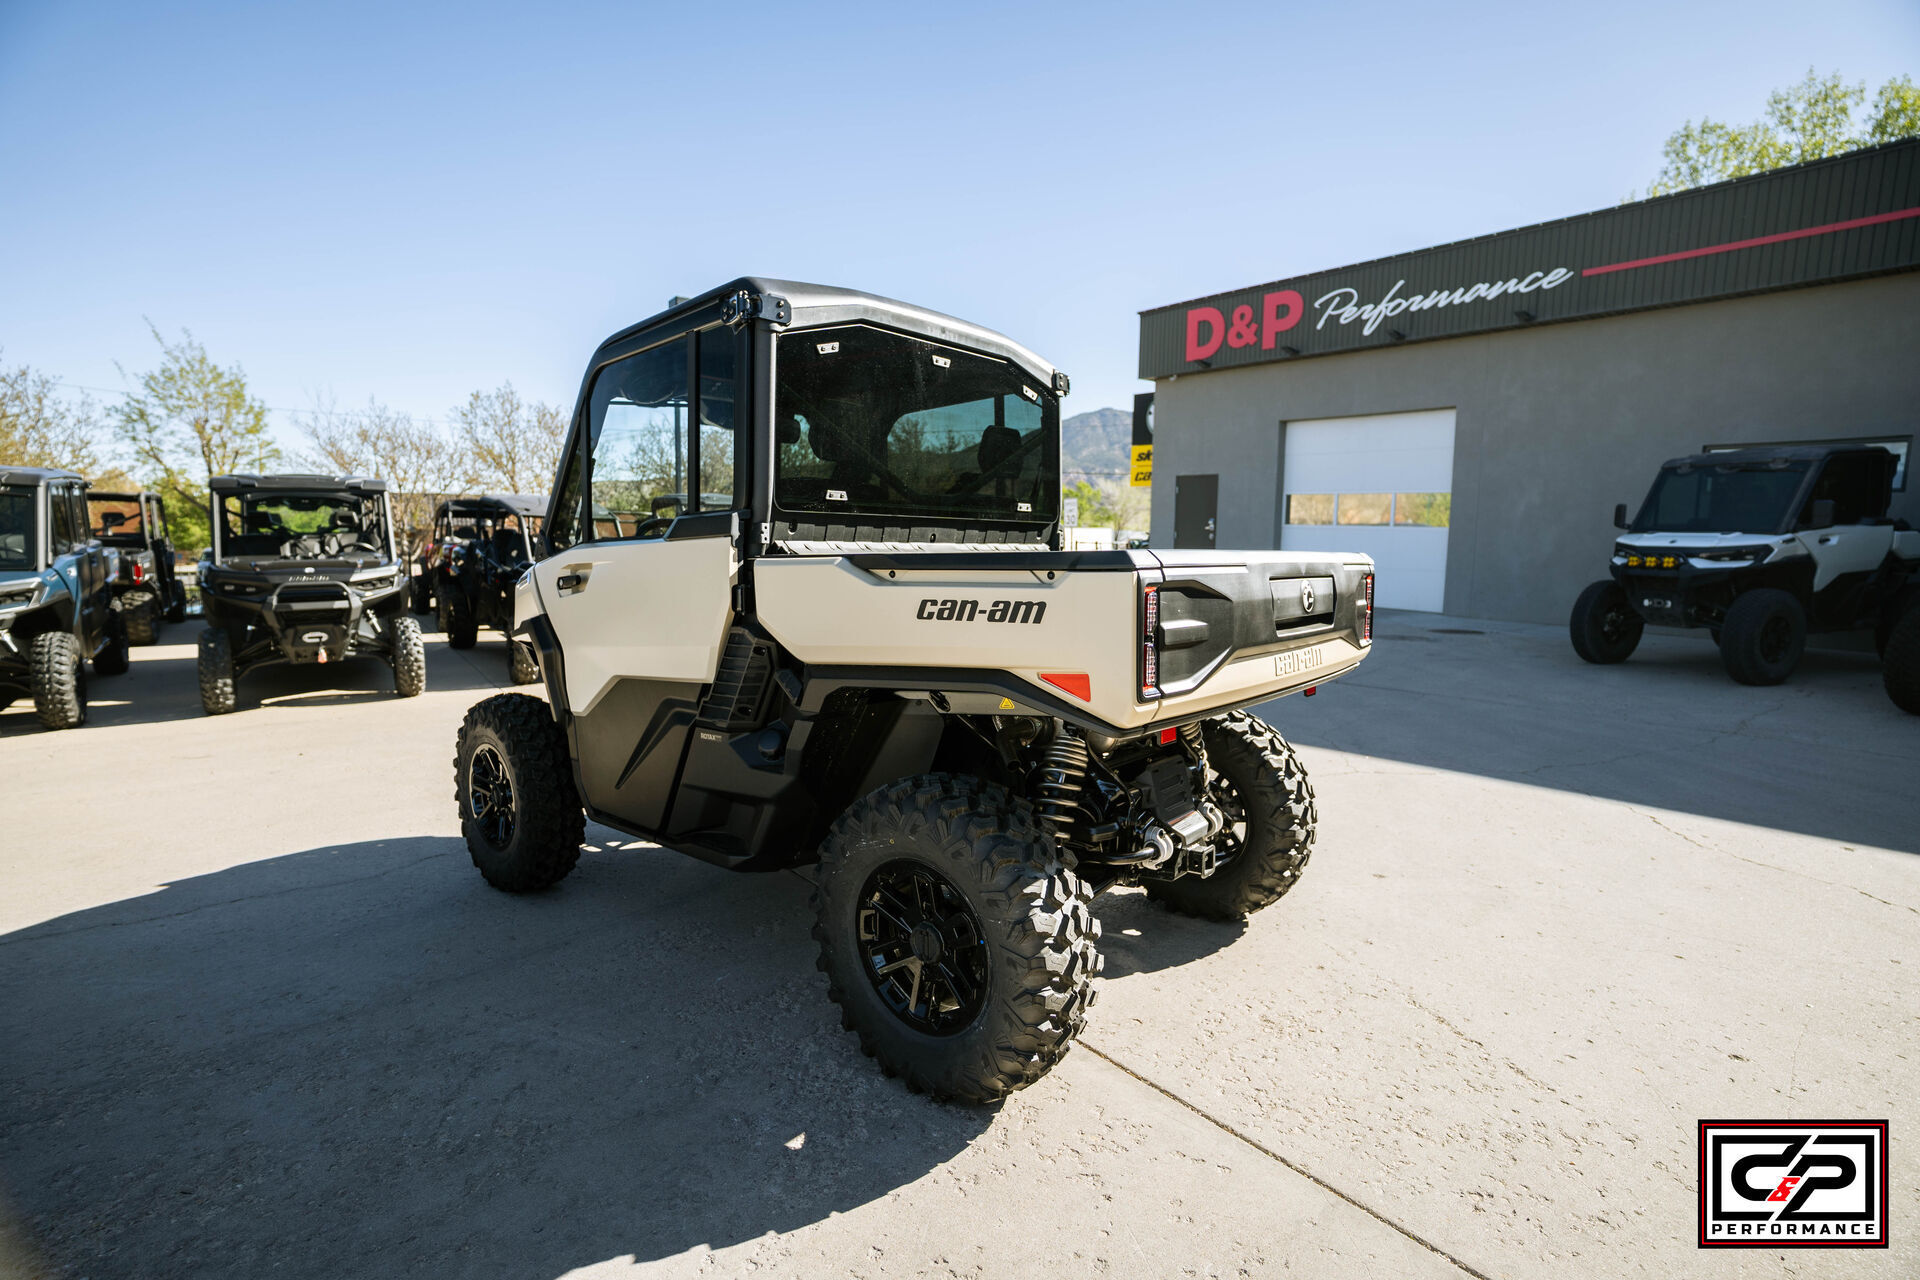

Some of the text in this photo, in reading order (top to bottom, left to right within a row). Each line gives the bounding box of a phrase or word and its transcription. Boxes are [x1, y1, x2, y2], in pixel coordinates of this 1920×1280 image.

[1185, 267, 1574, 362] D&P Performance
[916, 598, 1047, 624] can-am
[1274, 647, 1323, 677] can-am
